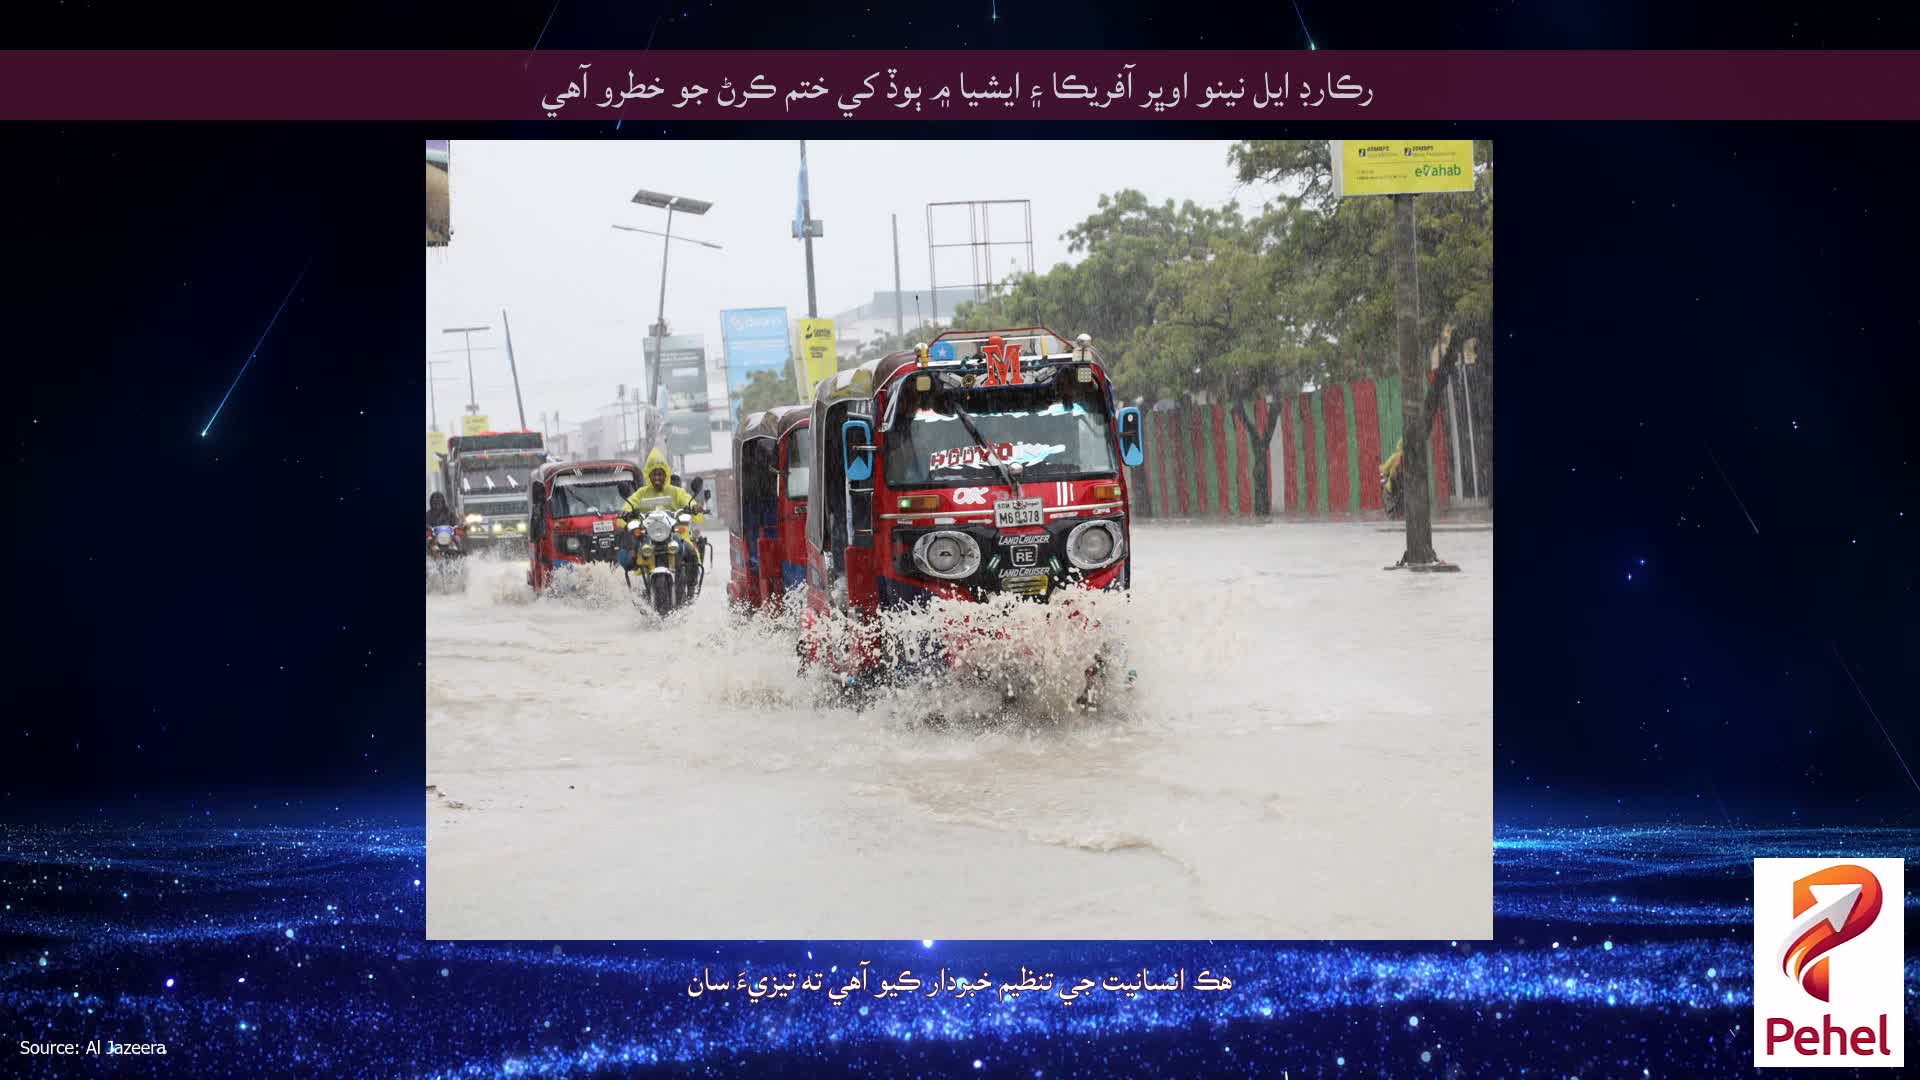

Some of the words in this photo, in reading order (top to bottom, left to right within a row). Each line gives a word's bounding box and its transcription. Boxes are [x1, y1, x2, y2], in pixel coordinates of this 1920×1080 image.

[980, 344, 1025, 386] M
[953, 487, 989, 504] OK
[1016, 552, 1034, 562] RE
